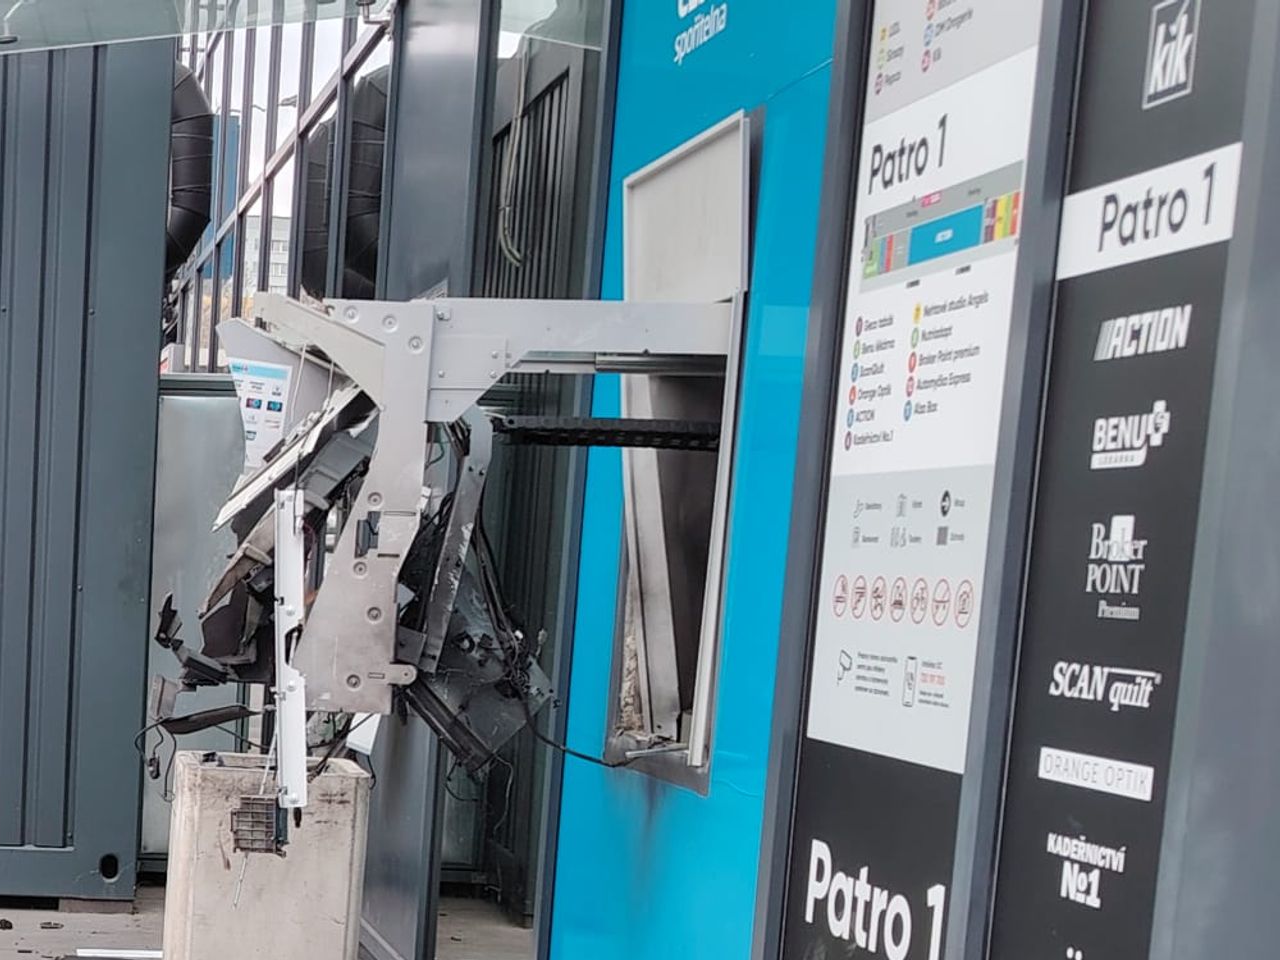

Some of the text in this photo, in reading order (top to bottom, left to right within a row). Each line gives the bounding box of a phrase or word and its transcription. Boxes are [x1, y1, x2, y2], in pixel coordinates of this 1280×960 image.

[1149, 11, 1193, 95] kik
[868, 113, 948, 195] Patro 1
[1098, 162, 1217, 253] Patro 1
[1094, 304, 1192, 361] ACTION
[1092, 413, 1148, 452] BENU
[1086, 563, 1145, 595] POINT
[1049, 660, 1154, 711] SCAN quilt
[1043, 753, 1150, 795] ORANGE OPTIK
[1046, 832, 1126, 873] KADEŘNICTVÍ
